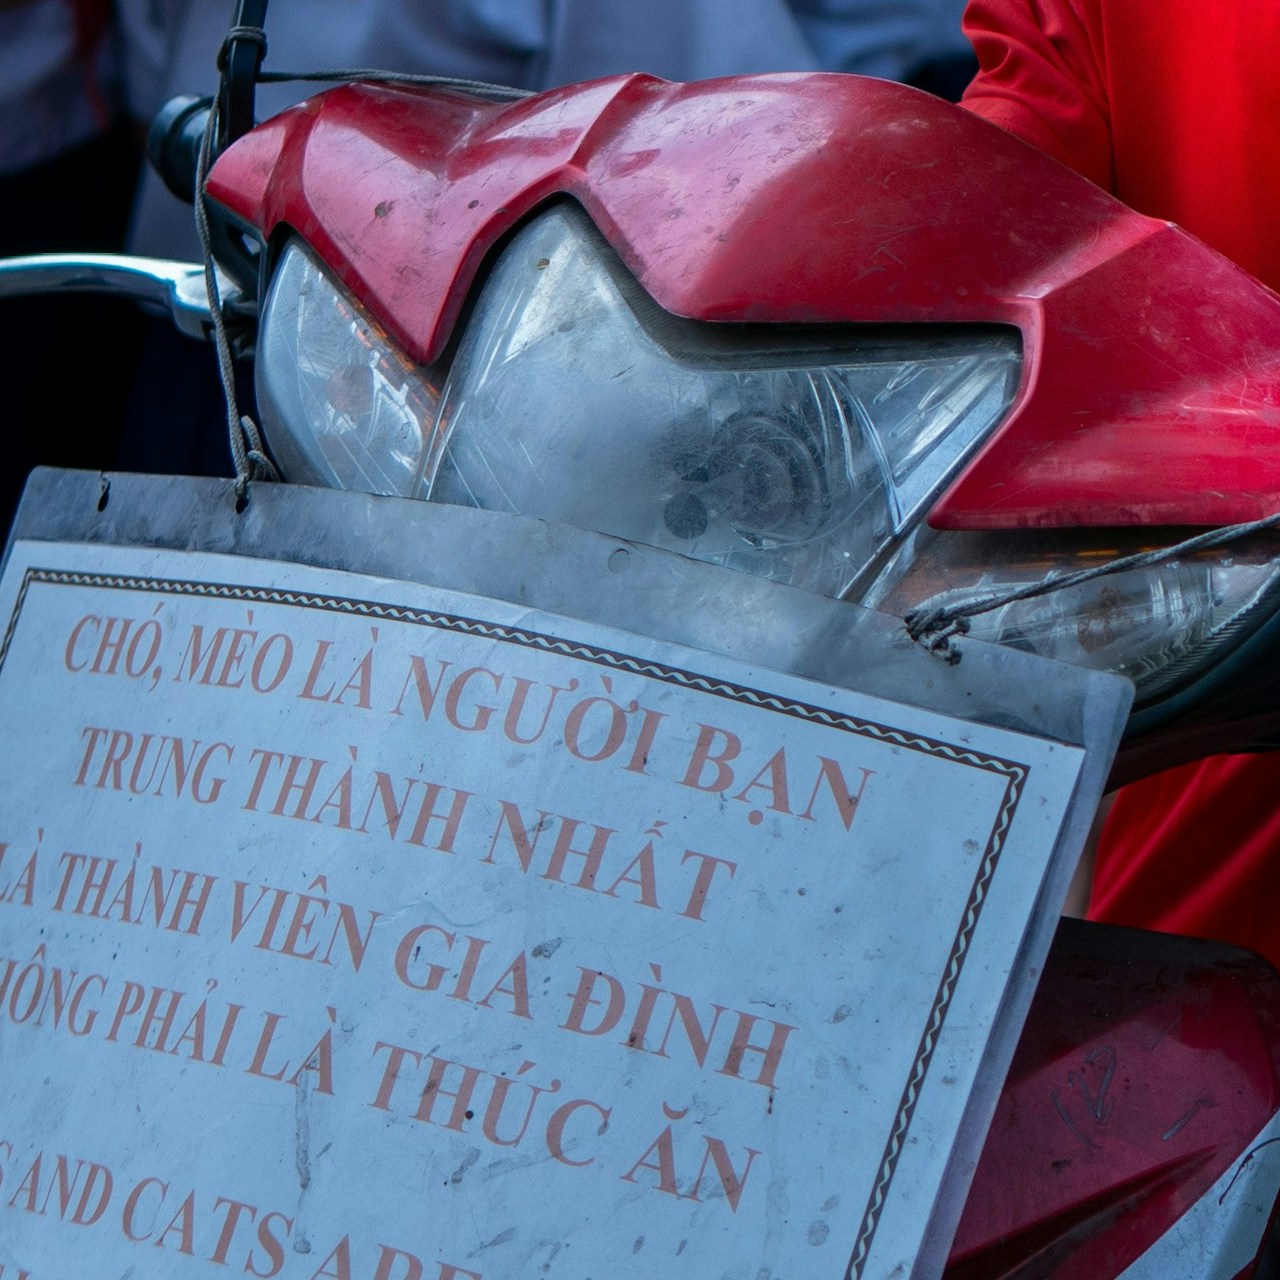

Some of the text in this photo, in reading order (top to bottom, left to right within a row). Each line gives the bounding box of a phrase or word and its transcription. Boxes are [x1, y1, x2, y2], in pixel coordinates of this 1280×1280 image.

[65, 601, 877, 832] CHÓ, MÈO LÀ NGƯỜI BẠN
[74, 726, 738, 923] TRUNG THÀNH NHẤT
[53, 842, 221, 936] THÀNH
[230, 874, 384, 974] VIÊN
[393, 923, 534, 1021] GIA
[558, 962, 800, 1090] ĐÌNH
[106, 978, 246, 1066] PHẢI
[245, 1006, 338, 1097] LÀ
[367, 1042, 613, 1168] THỨC
[619, 1100, 763, 1214] ĂN
[8, 1150, 114, 1227] AND
[121, 1175, 295, 1279] CATS
